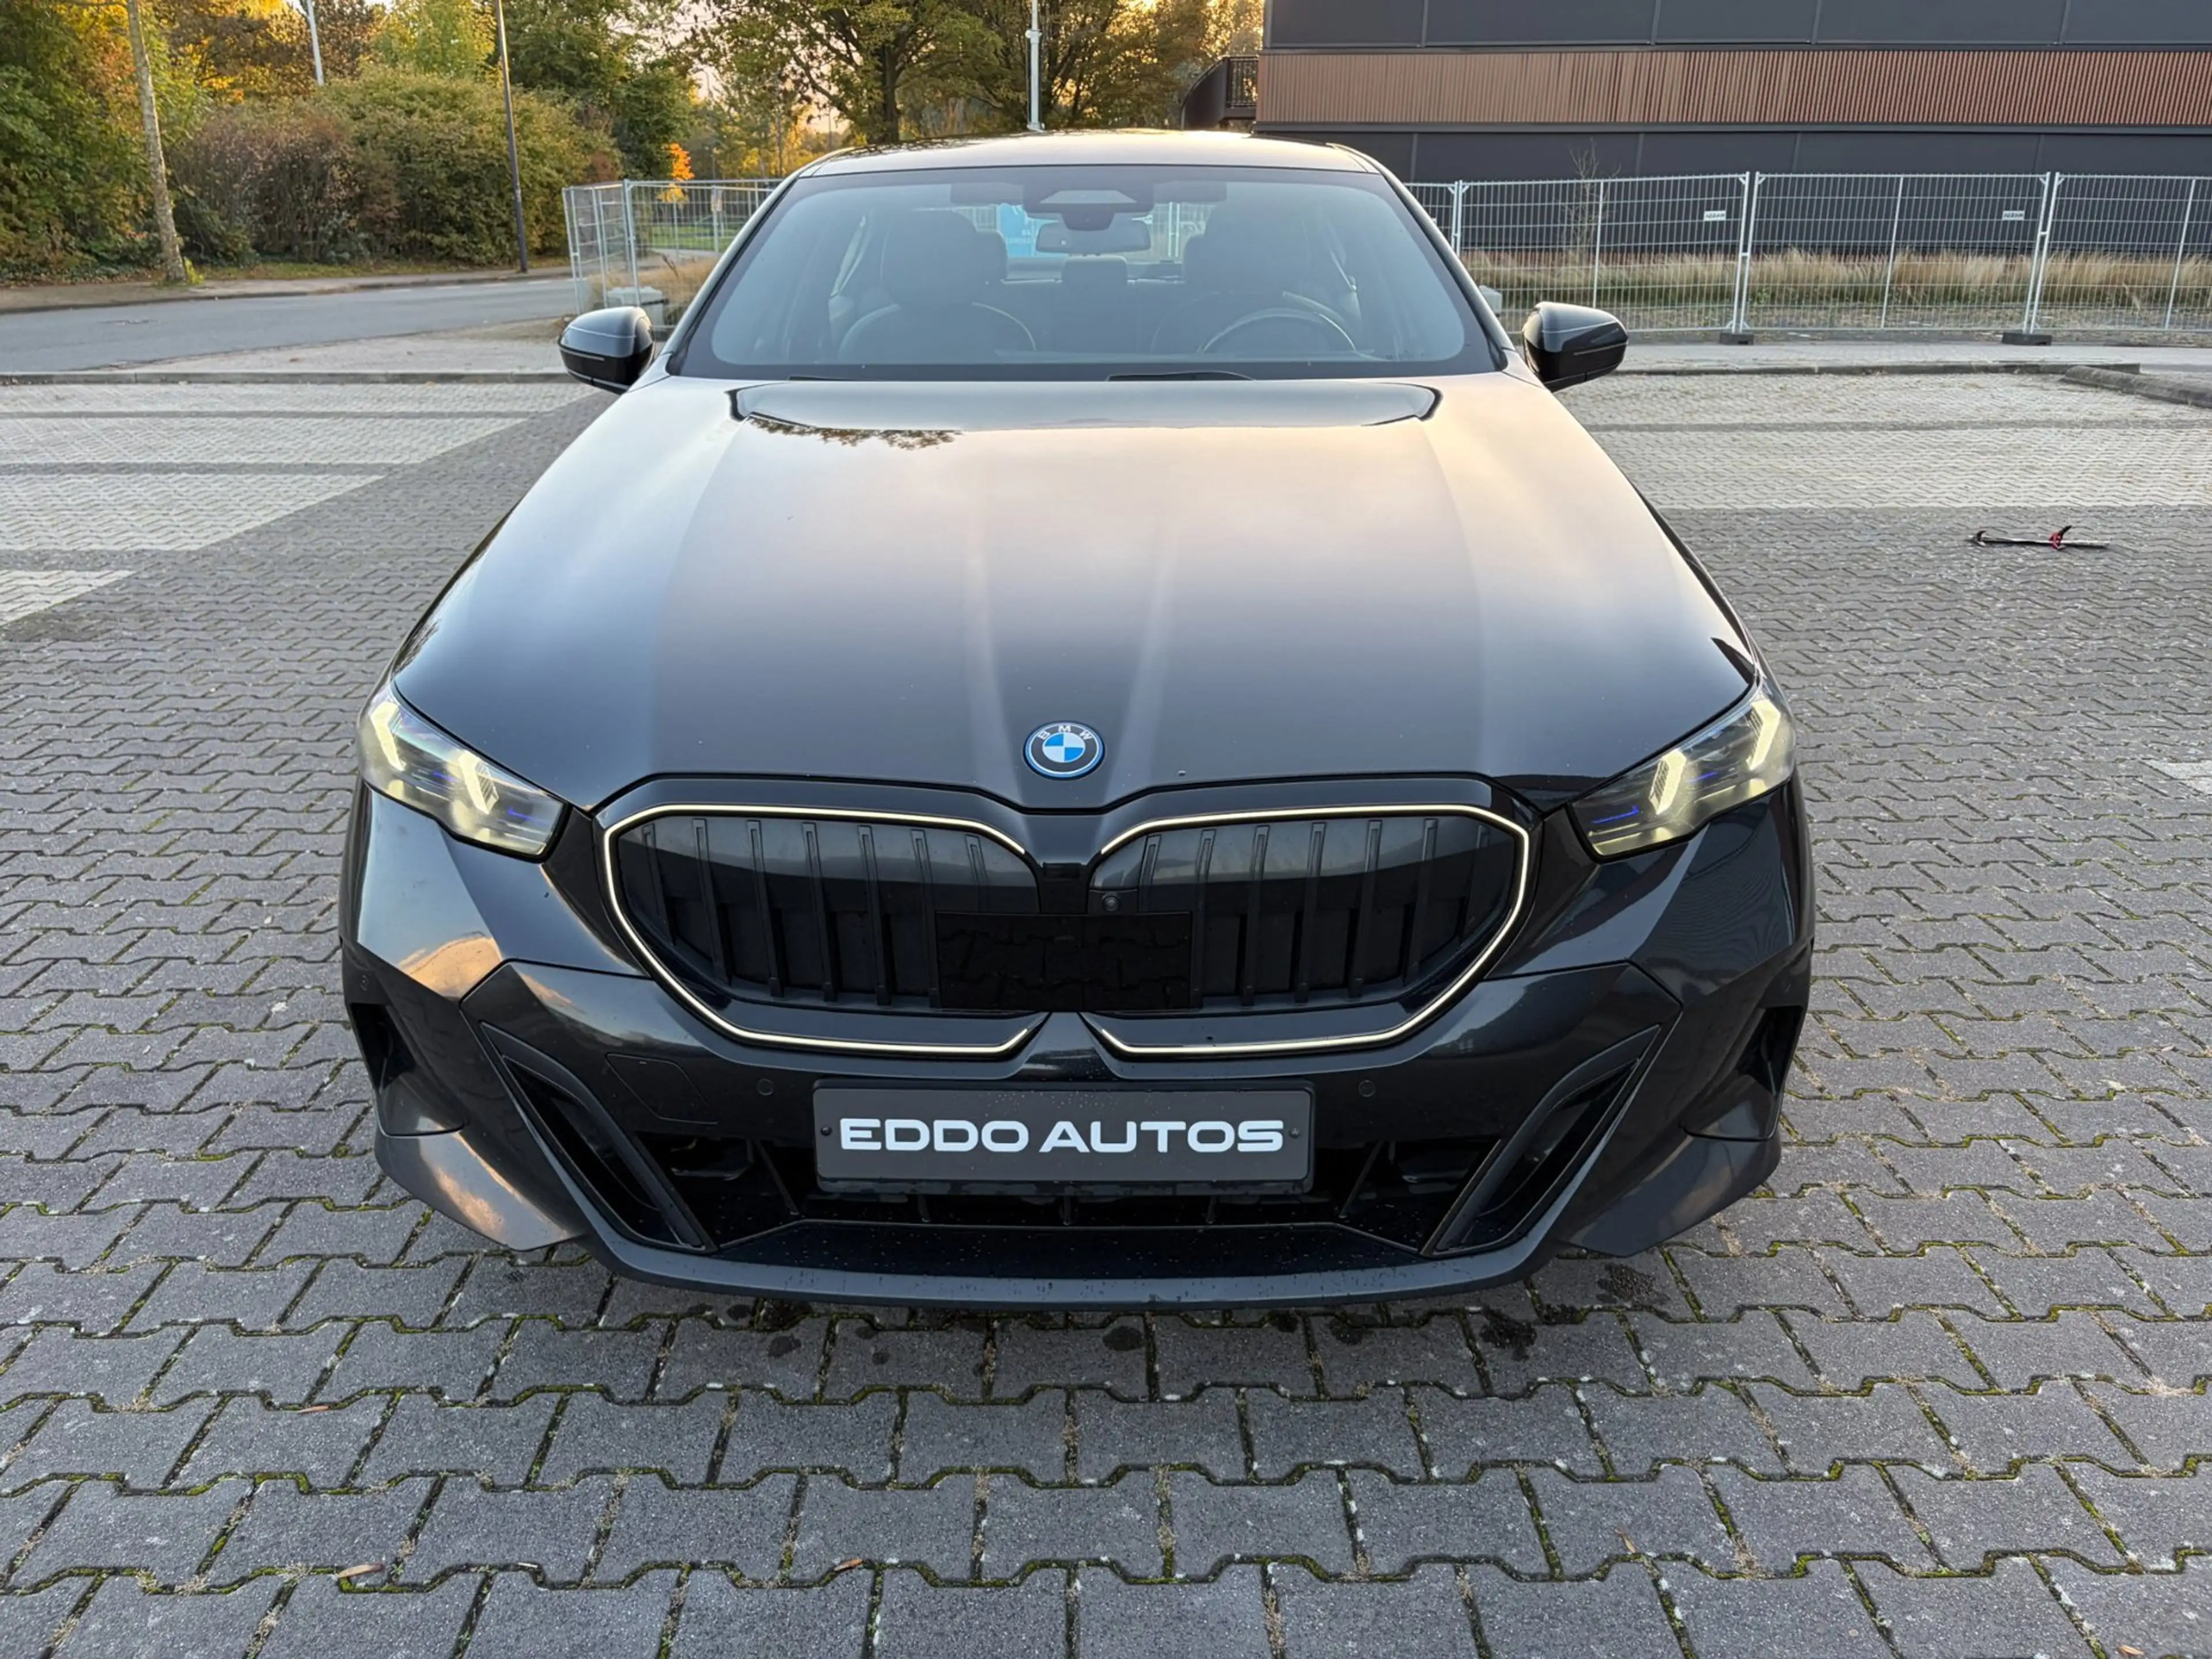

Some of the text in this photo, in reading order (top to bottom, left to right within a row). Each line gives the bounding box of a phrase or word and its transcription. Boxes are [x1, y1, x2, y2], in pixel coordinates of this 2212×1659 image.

[1037, 725, 1092, 740] BMW
[840, 1118, 1284, 1153] EDDO AUTOS
